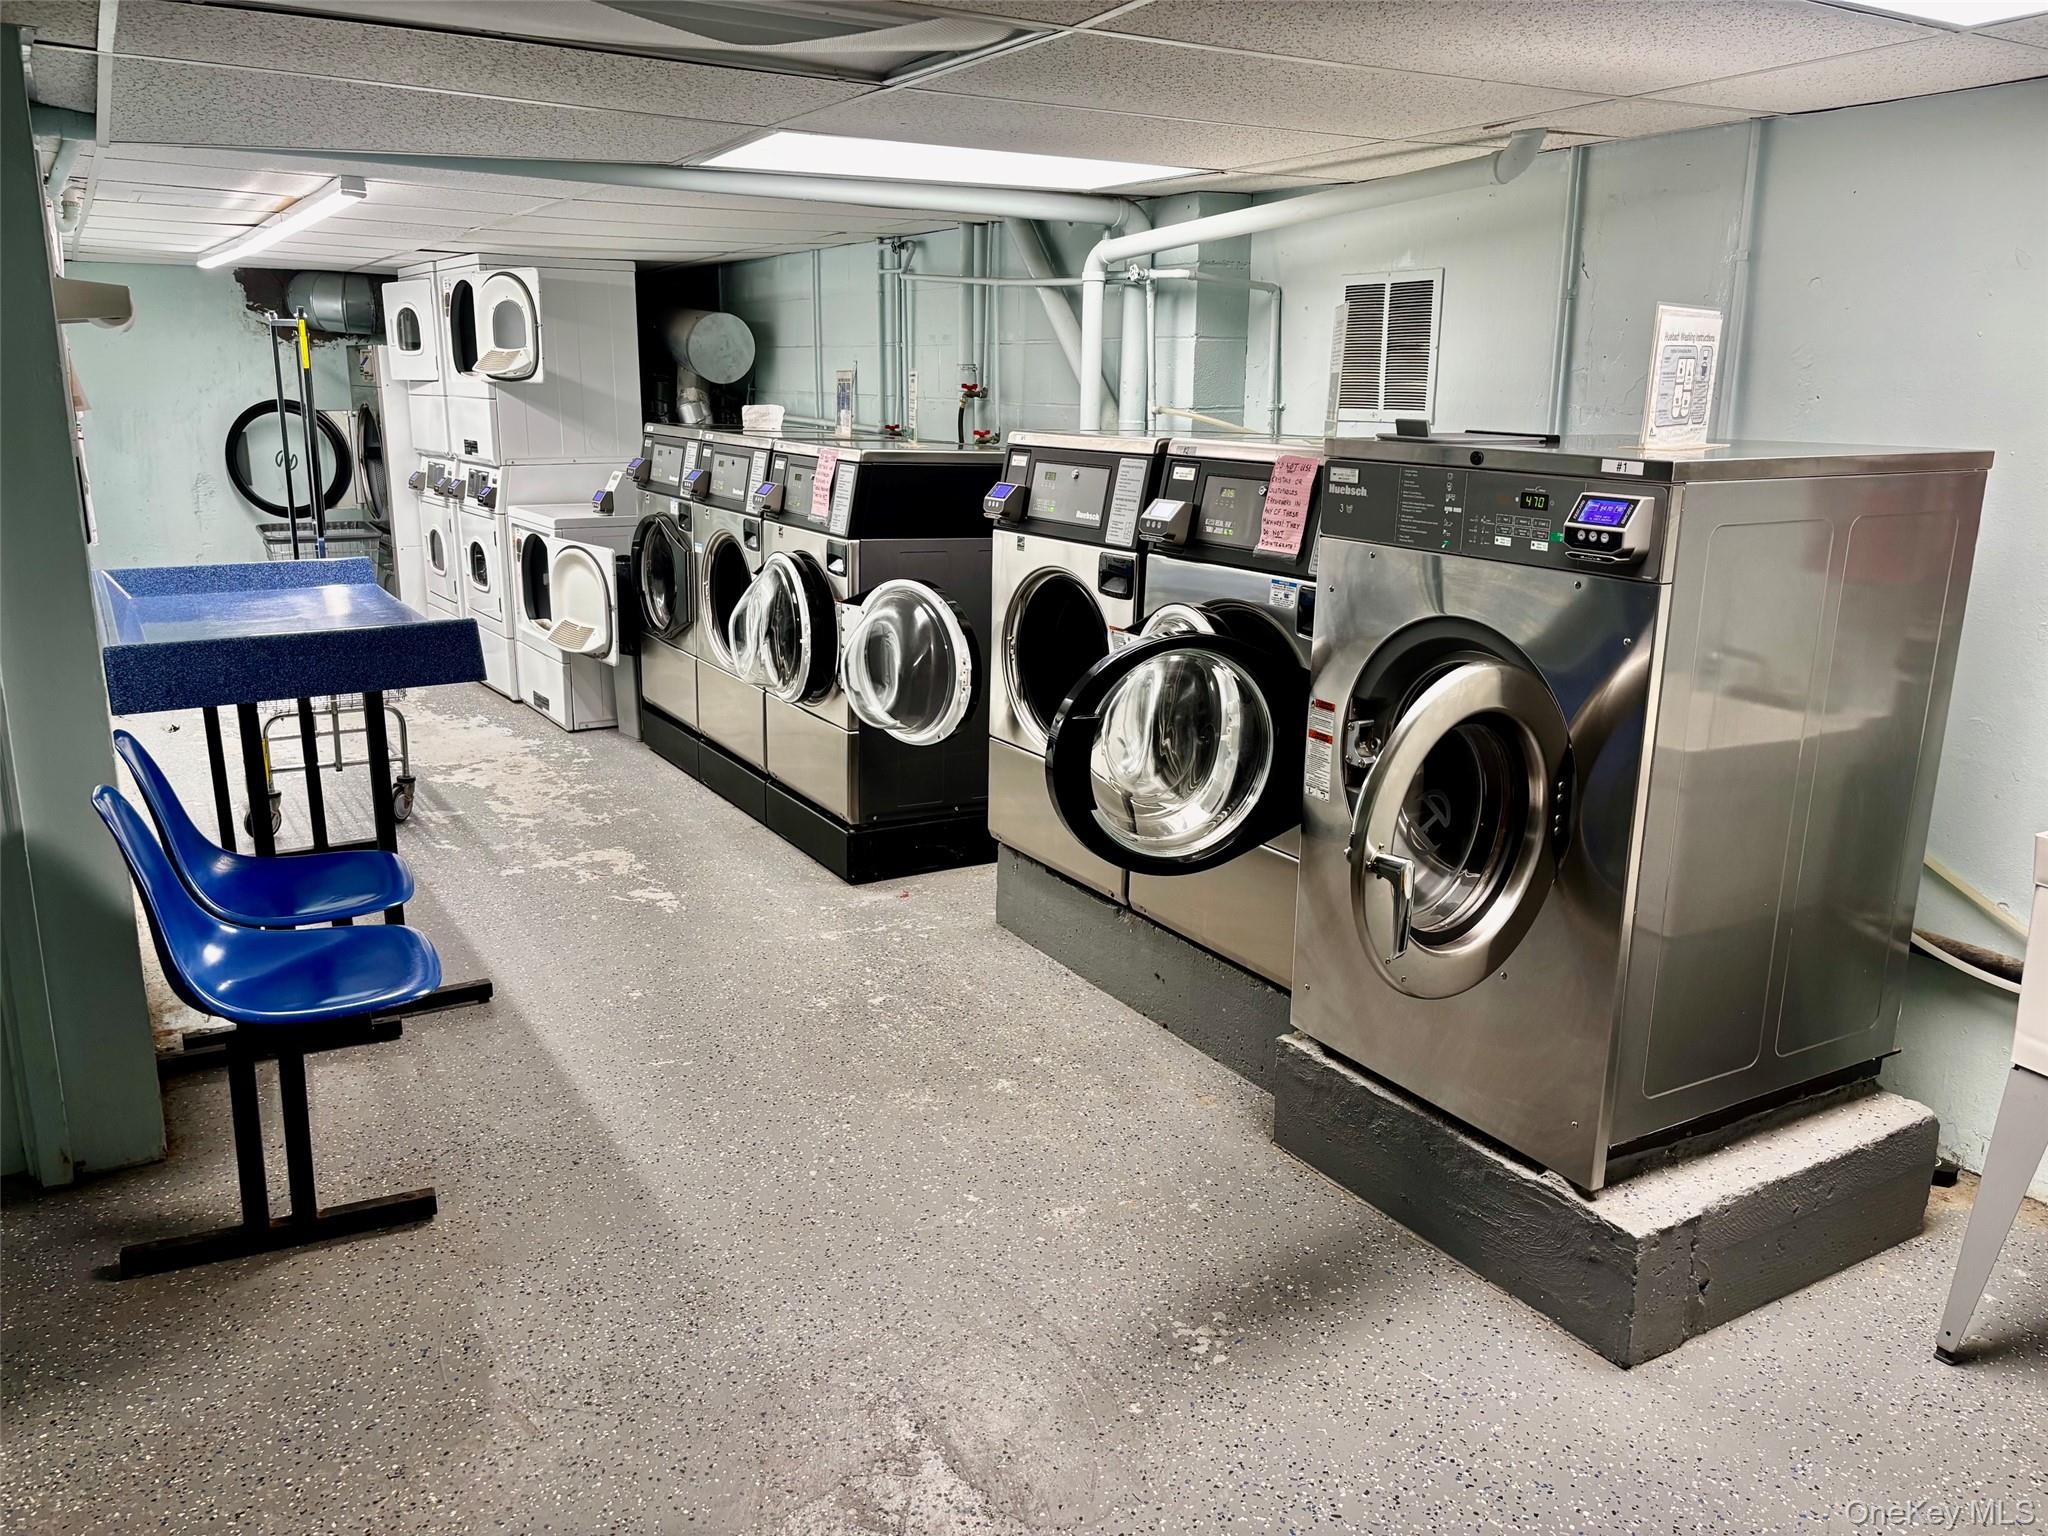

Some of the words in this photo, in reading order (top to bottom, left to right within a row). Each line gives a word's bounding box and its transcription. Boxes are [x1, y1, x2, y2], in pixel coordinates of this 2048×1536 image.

[1286, 463, 1299, 471] NOT
[1300, 464, 1312, 472] USE
[1616, 461, 1627, 472] #1
[1329, 483, 1367, 497] Huebsch
[1525, 495, 1545, 508] 470
[1283, 509, 1299, 517] THESE
[1339, 503, 1344, 513] 3
[1076, 510, 1100, 520] Huebsch
[1286, 521, 1300, 529] THEY
